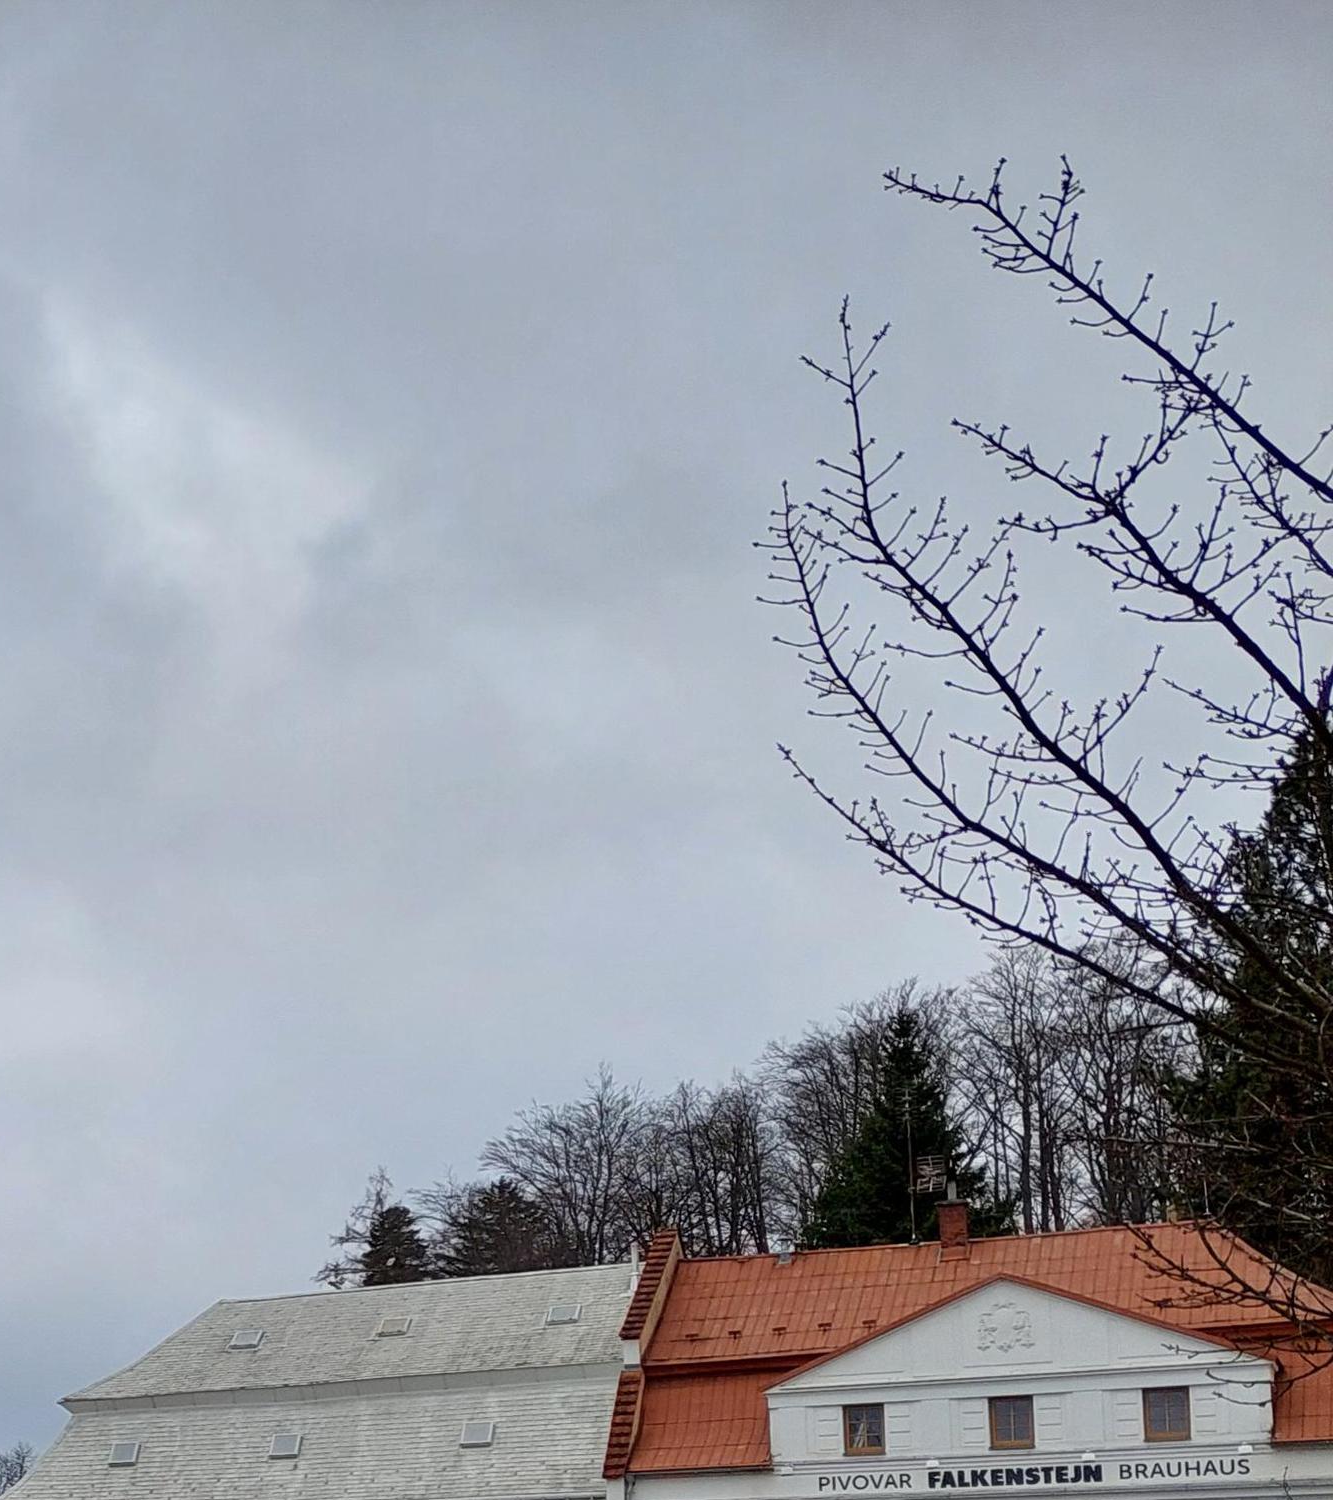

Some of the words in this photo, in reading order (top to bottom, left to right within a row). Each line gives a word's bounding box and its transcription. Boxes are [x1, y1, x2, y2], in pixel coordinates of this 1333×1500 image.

[818, 1473, 912, 1491] PIVOVAR
[927, 1464, 1103, 1489] FALKENSTEJN
[1119, 1459, 1251, 1480] BRAUHAUS
